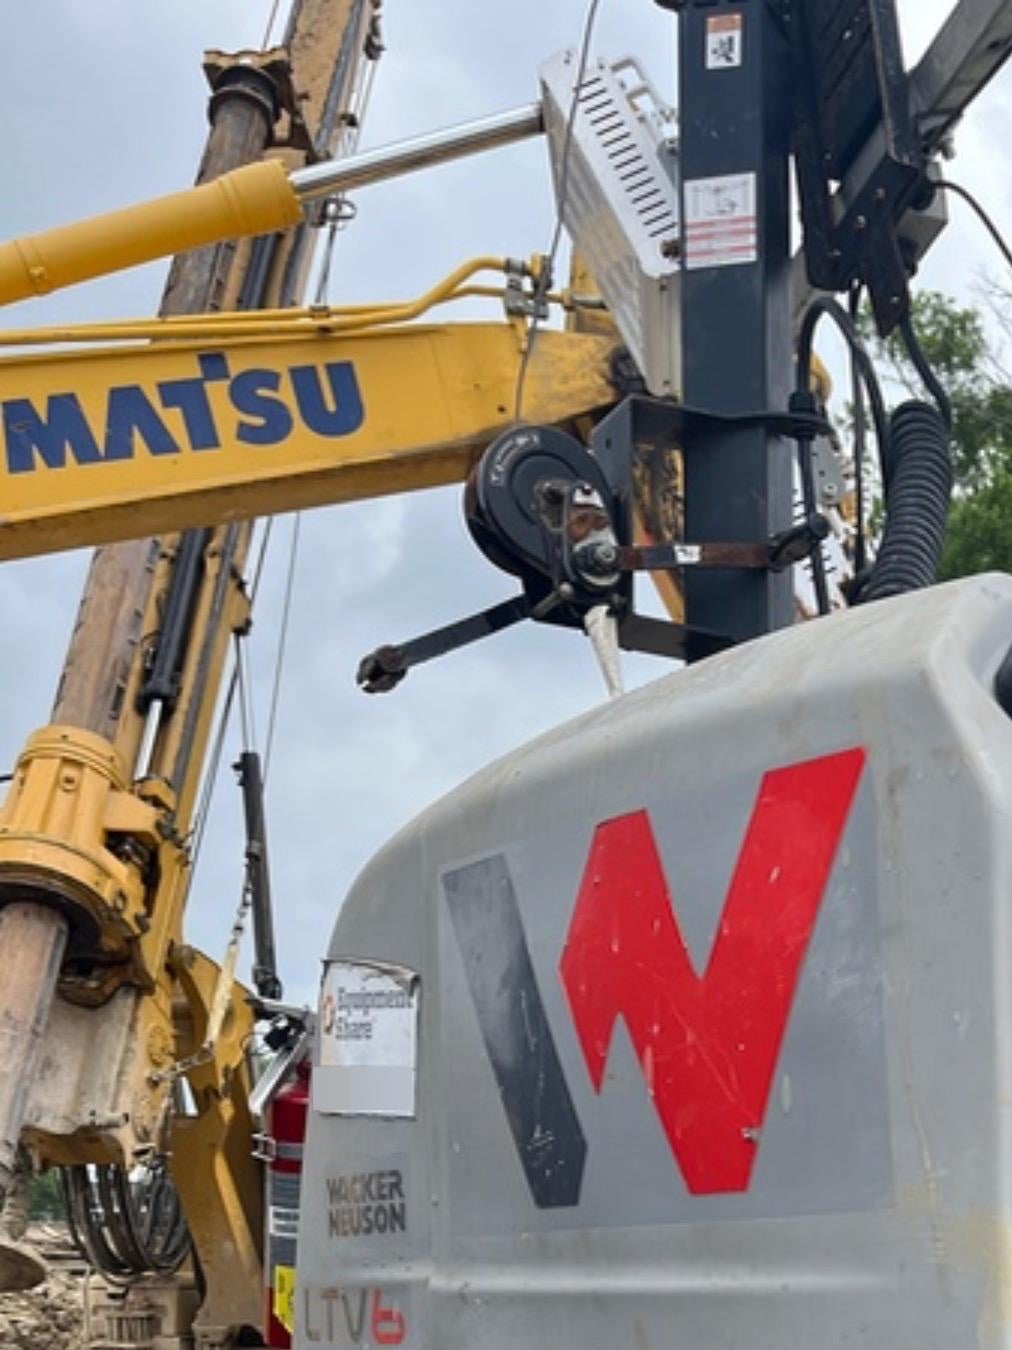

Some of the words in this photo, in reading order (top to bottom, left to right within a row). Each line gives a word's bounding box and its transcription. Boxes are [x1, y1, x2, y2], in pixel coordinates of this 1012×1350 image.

[337, 986, 414, 1016] Equipment
[326, 1170, 405, 1206] WACKER
[328, 1202, 407, 1238] NEUSON
[303, 1286, 408, 1346] LTV6
